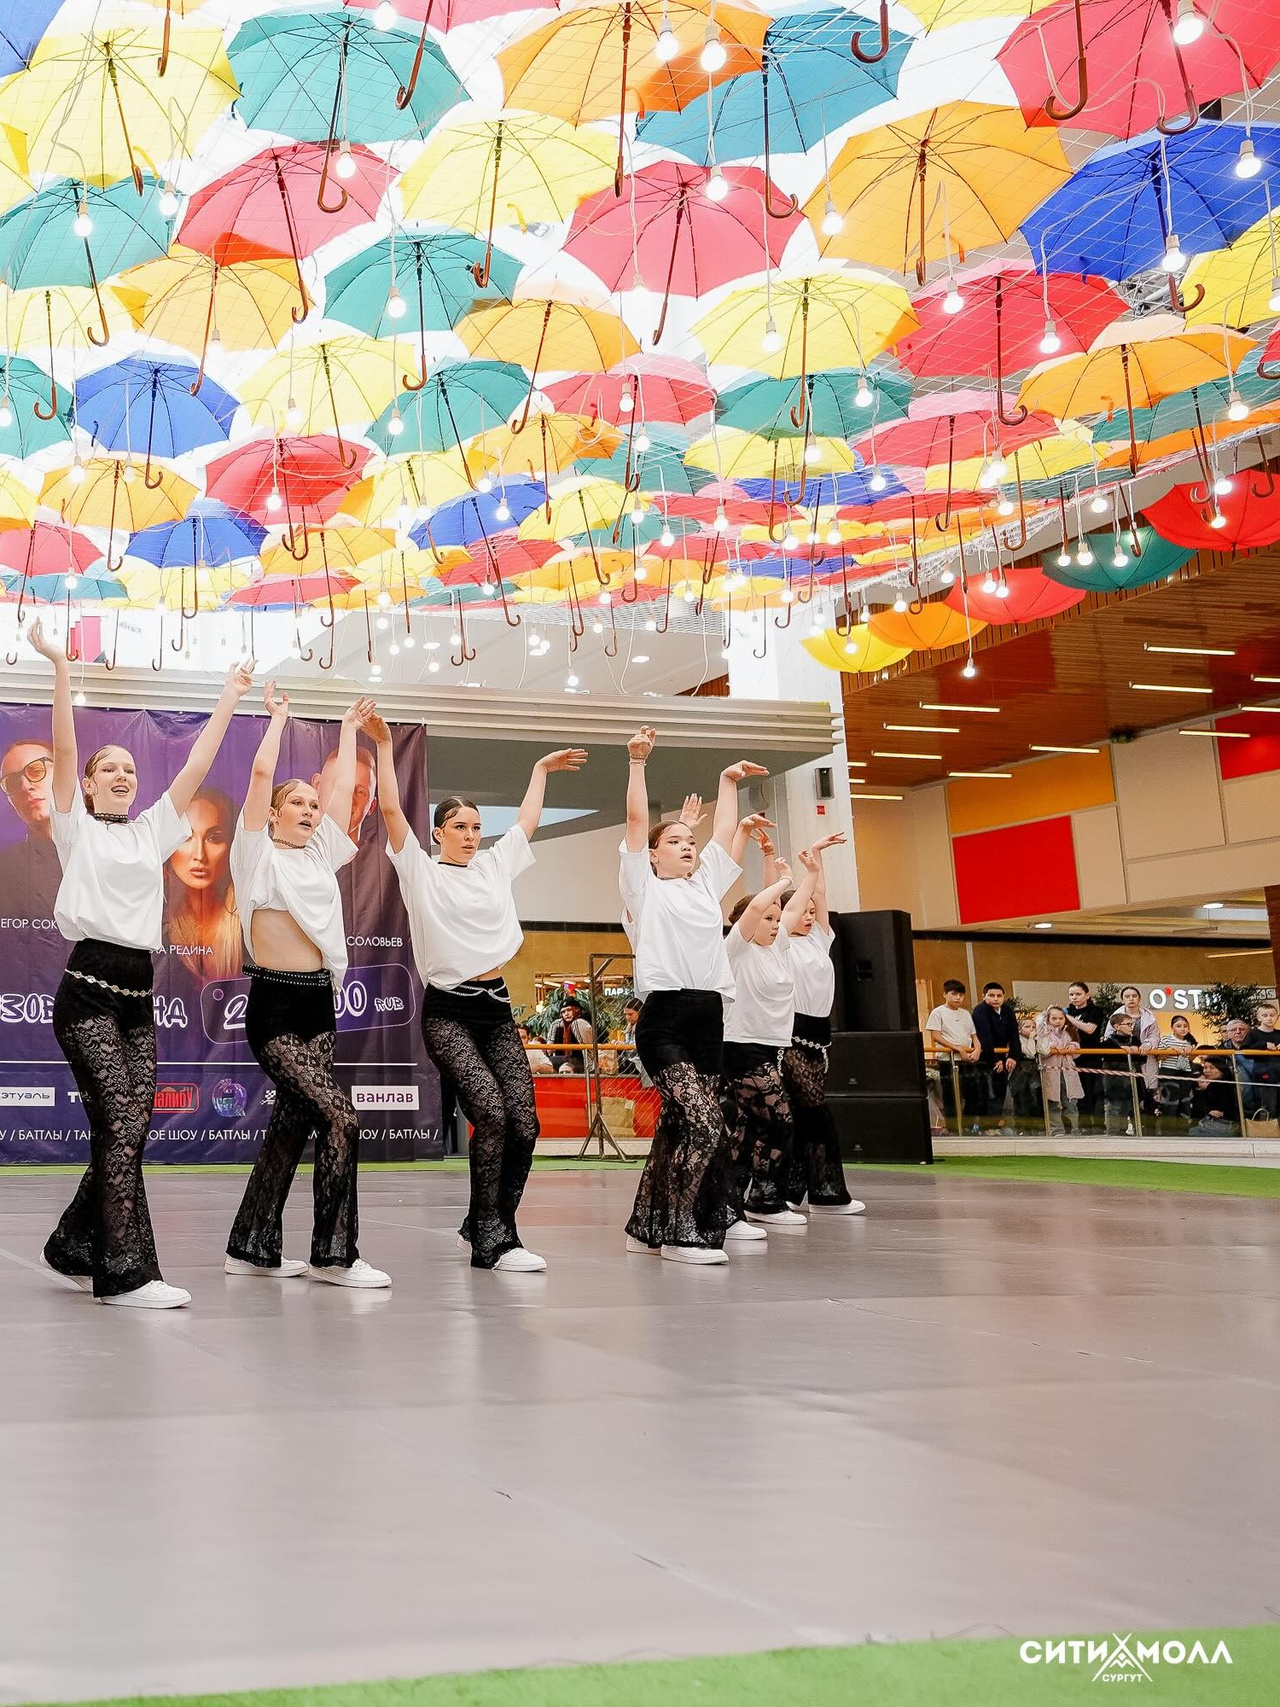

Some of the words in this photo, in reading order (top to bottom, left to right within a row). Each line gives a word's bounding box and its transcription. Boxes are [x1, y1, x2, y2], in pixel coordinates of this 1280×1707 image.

[0, 918, 29, 929] ЕГОР
[346, 935, 403, 947] СОЛОВЬЕВ
[169, 944, 214, 956] РЕДИНА
[1149, 986, 1221, 1010] O'ST
[356, 1092, 414, 1103] ванлав
[168, 1129, 198, 1141] ШОУ
